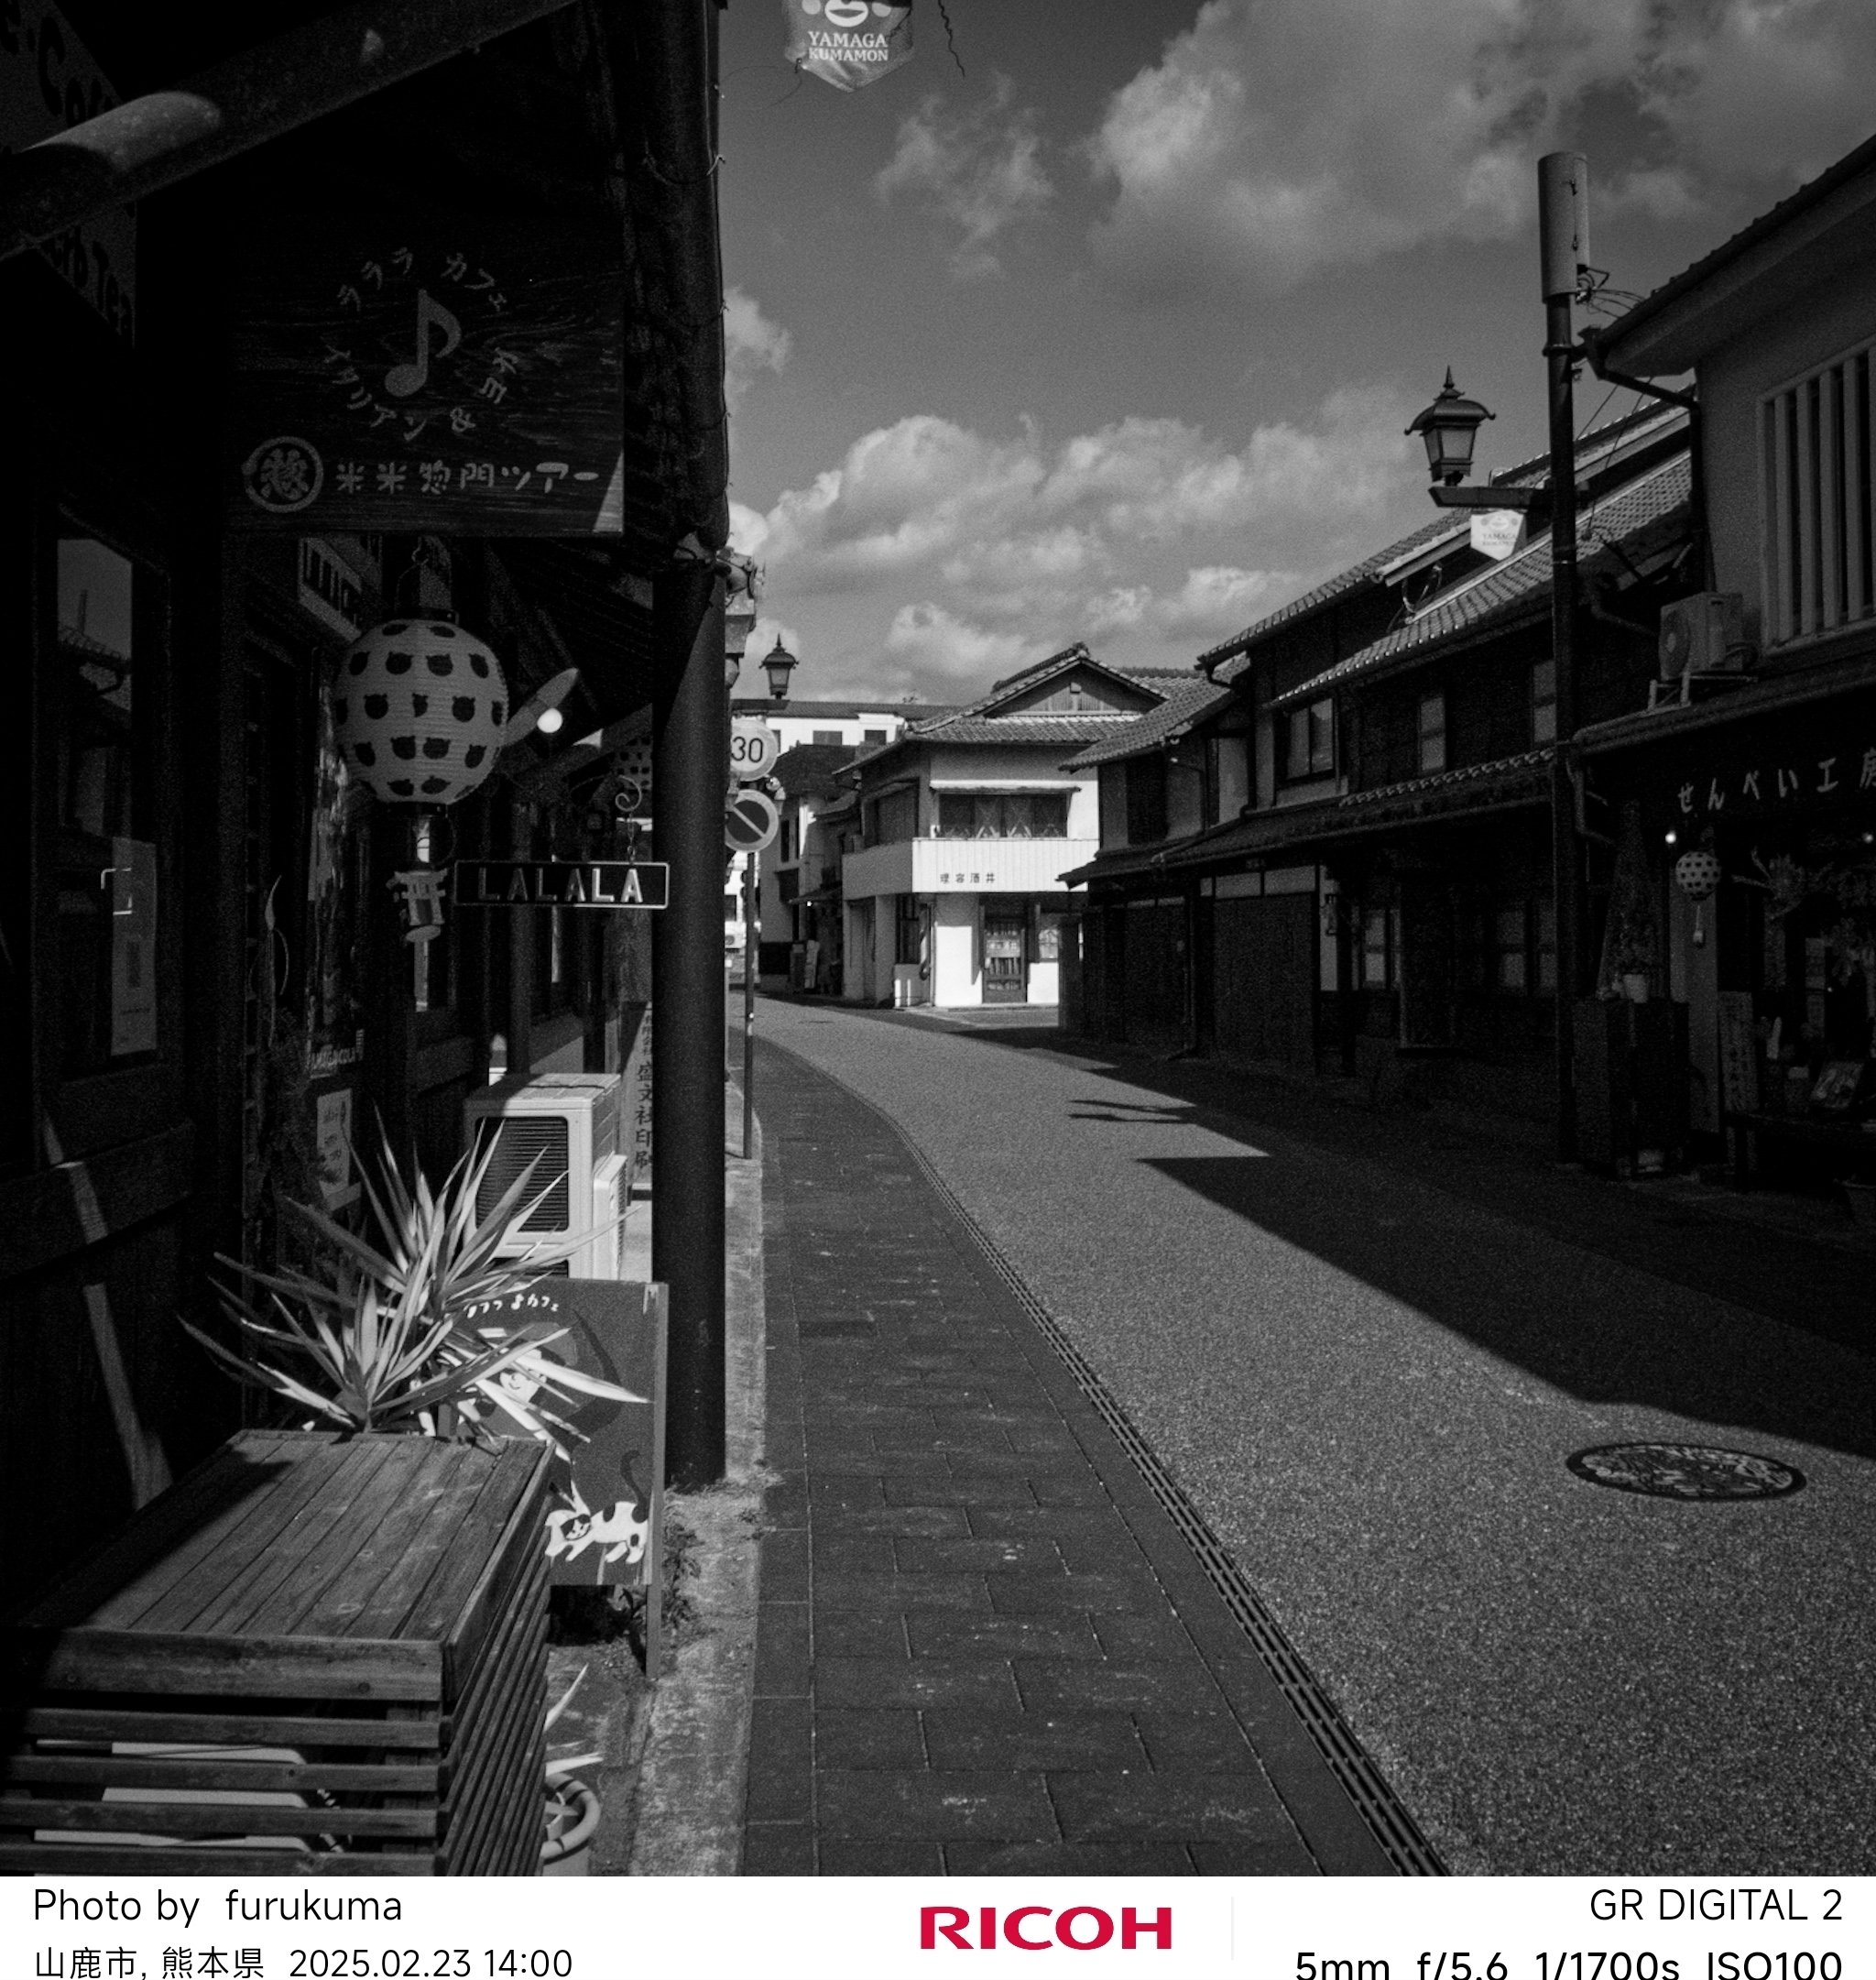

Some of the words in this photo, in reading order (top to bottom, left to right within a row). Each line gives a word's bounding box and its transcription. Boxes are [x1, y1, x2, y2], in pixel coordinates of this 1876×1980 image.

[807, 31, 889, 48] YAMAGA
[808, 48, 889, 61] KUMAMON
[336, 246, 414, 313] ラララ
[440, 251, 507, 312] カフェ
[322, 343, 428, 442] イタリアン
[449, 407, 477, 432] &
[335, 459, 600, 495] 米米惣門ツアー
[731, 737, 764, 762] 30
[477, 867, 644, 903] LALALA
